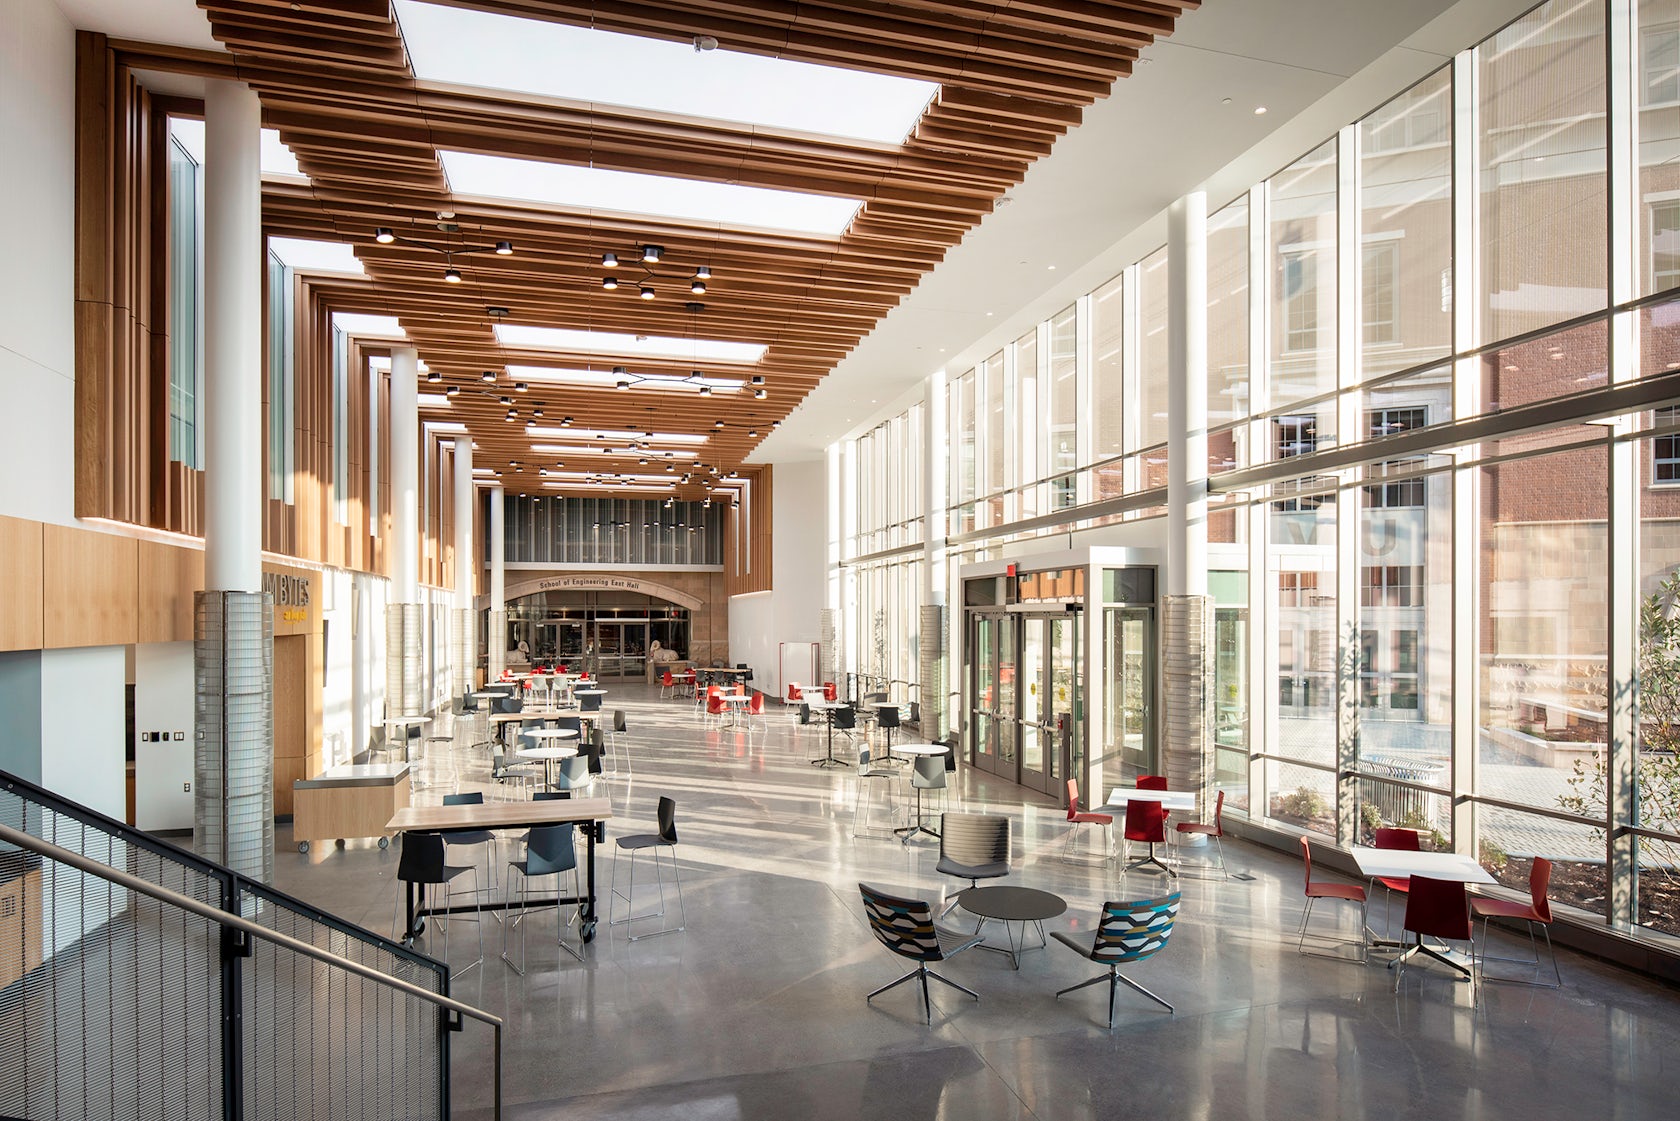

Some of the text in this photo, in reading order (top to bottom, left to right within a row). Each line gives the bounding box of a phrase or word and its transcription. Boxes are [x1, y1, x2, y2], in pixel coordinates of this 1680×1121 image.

[280, 575, 310, 606] BYTES
[540, 578, 639, 589] School of Engineering East Hall
